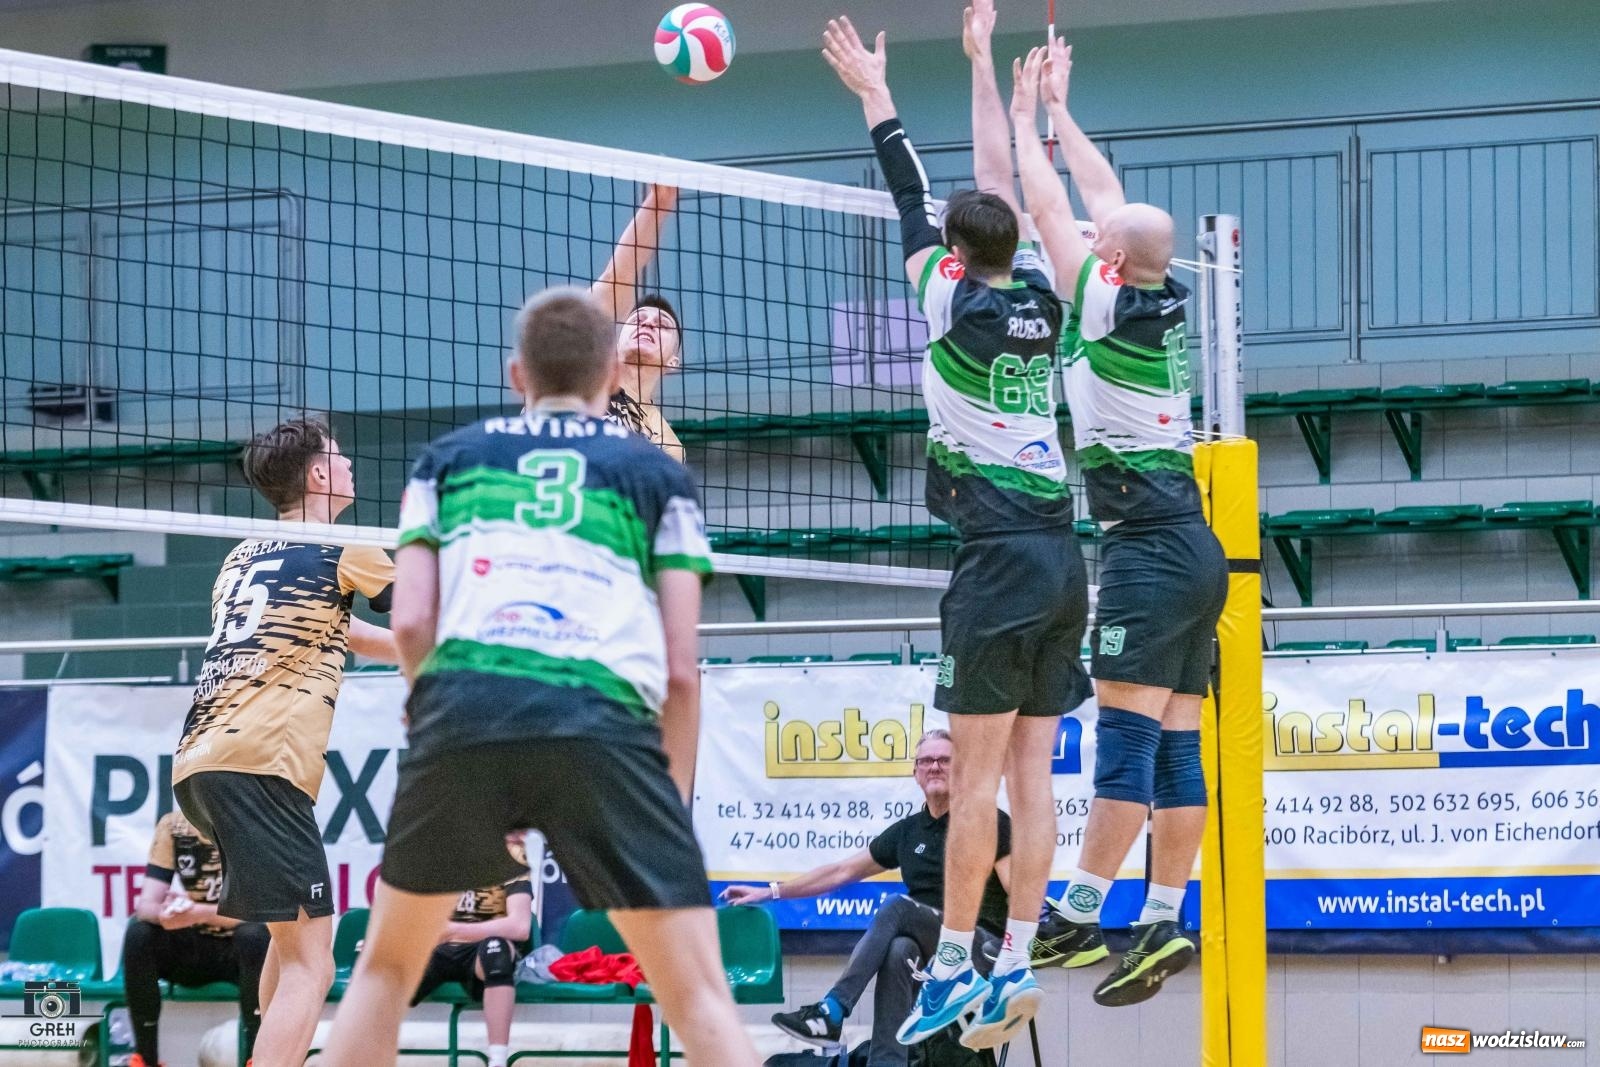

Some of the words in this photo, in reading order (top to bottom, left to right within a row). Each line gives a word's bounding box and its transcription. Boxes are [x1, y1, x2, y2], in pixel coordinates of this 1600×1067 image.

[514, 448, 587, 532] 3
[1263, 689, 1600, 758] instal-tech
[717, 801, 746, 818] tel.
[752, 802, 775, 820] 32
[781, 801, 815, 819] 414
[821, 801, 847, 819] 92
[848, 801, 874, 820] 88,
[884, 801, 912, 818] 502
[1275, 796, 1314, 814] 414
[1320, 796, 1343, 814] 92
[1350, 794, 1378, 814] 88,
[1390, 794, 1426, 813] 502
[1433, 792, 1470, 812] 632
[1477, 792, 1520, 812] 695,
[1532, 790, 1568, 809] 606
[1574, 789, 1600, 809] 36
[730, 832, 800, 850] 47-400
[806, 830, 878, 849] Racibór
[1303, 824, 1395, 847] Racibórz,
[1401, 824, 1425, 843] ul.
[1430, 823, 1444, 843] J.
[1450, 827, 1488, 842] von
[1495, 820, 1600, 842] Eichendorf
[1317, 887, 1546, 918] www.instal-tech.pl
